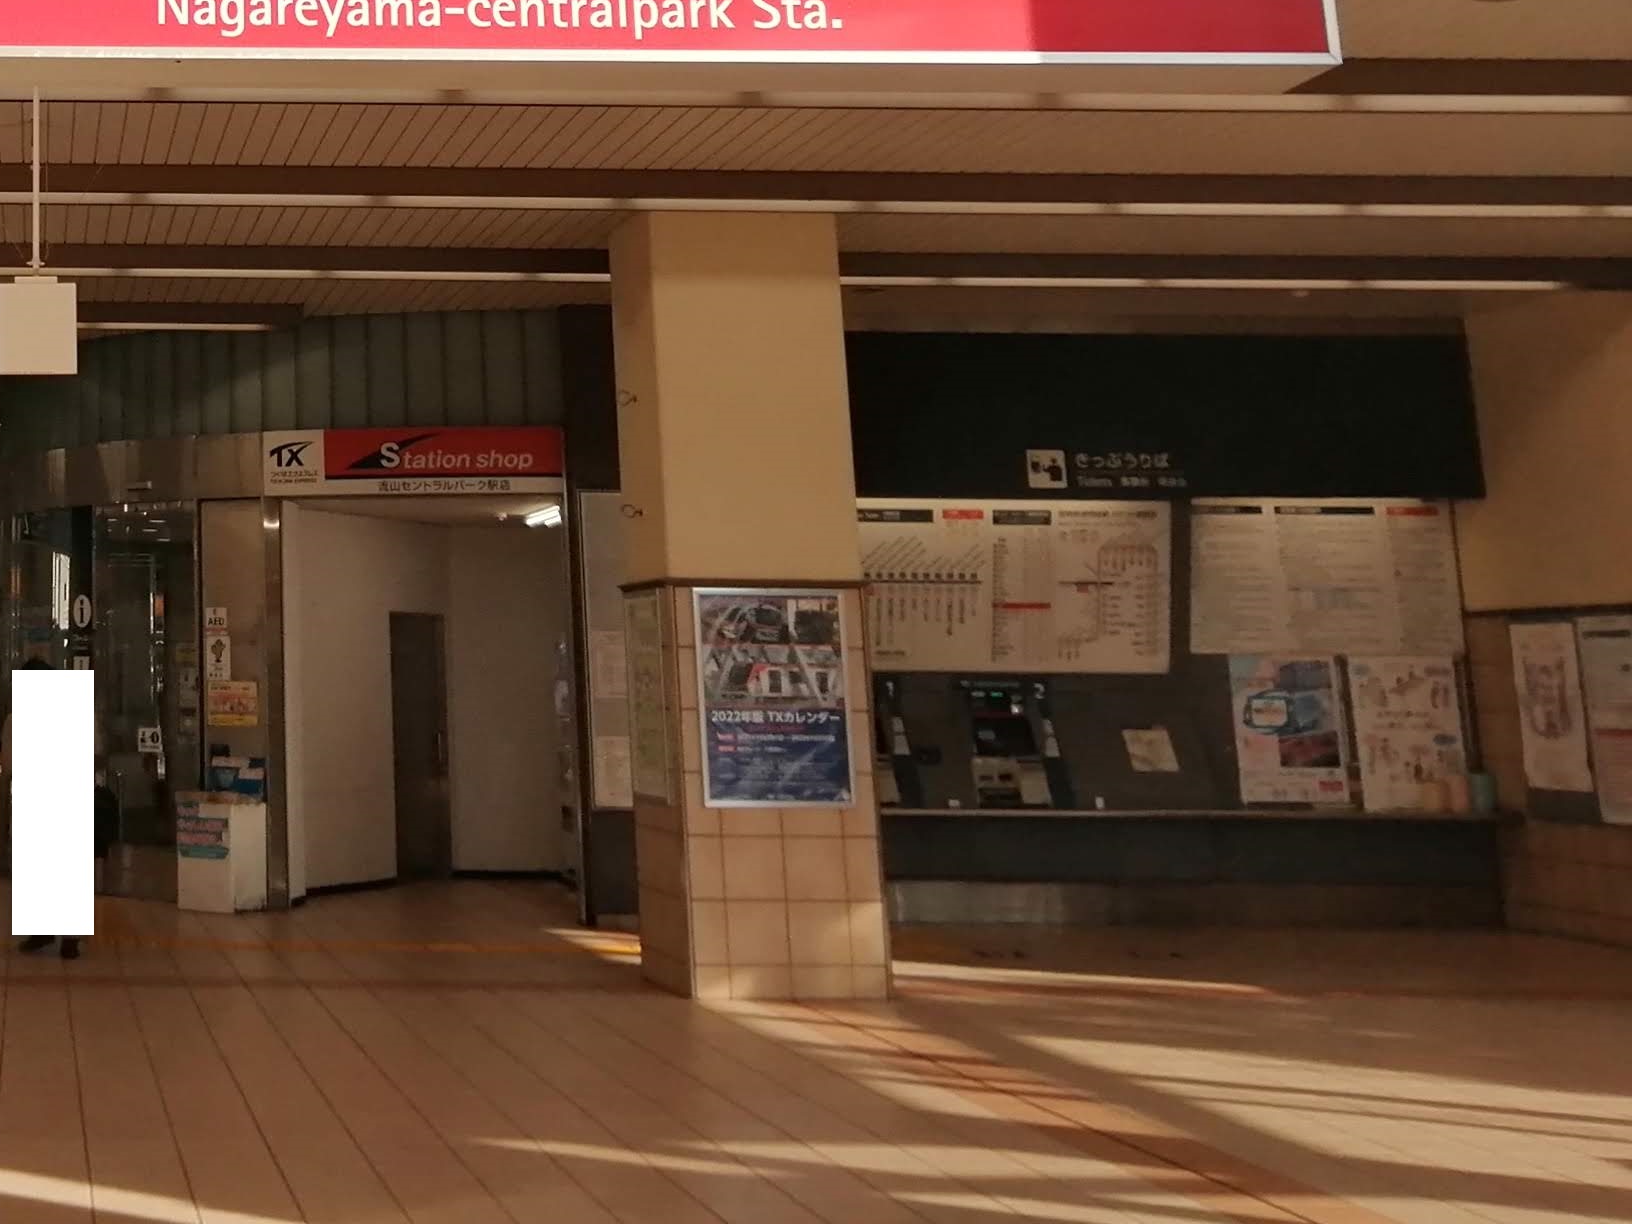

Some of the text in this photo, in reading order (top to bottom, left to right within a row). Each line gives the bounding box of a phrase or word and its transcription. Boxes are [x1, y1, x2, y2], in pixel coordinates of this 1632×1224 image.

[379, 441, 534, 472] Station shop
[377, 479, 511, 492] 流山セントラルパーク駅店
[767, 710, 842, 725] TXカレンダー
